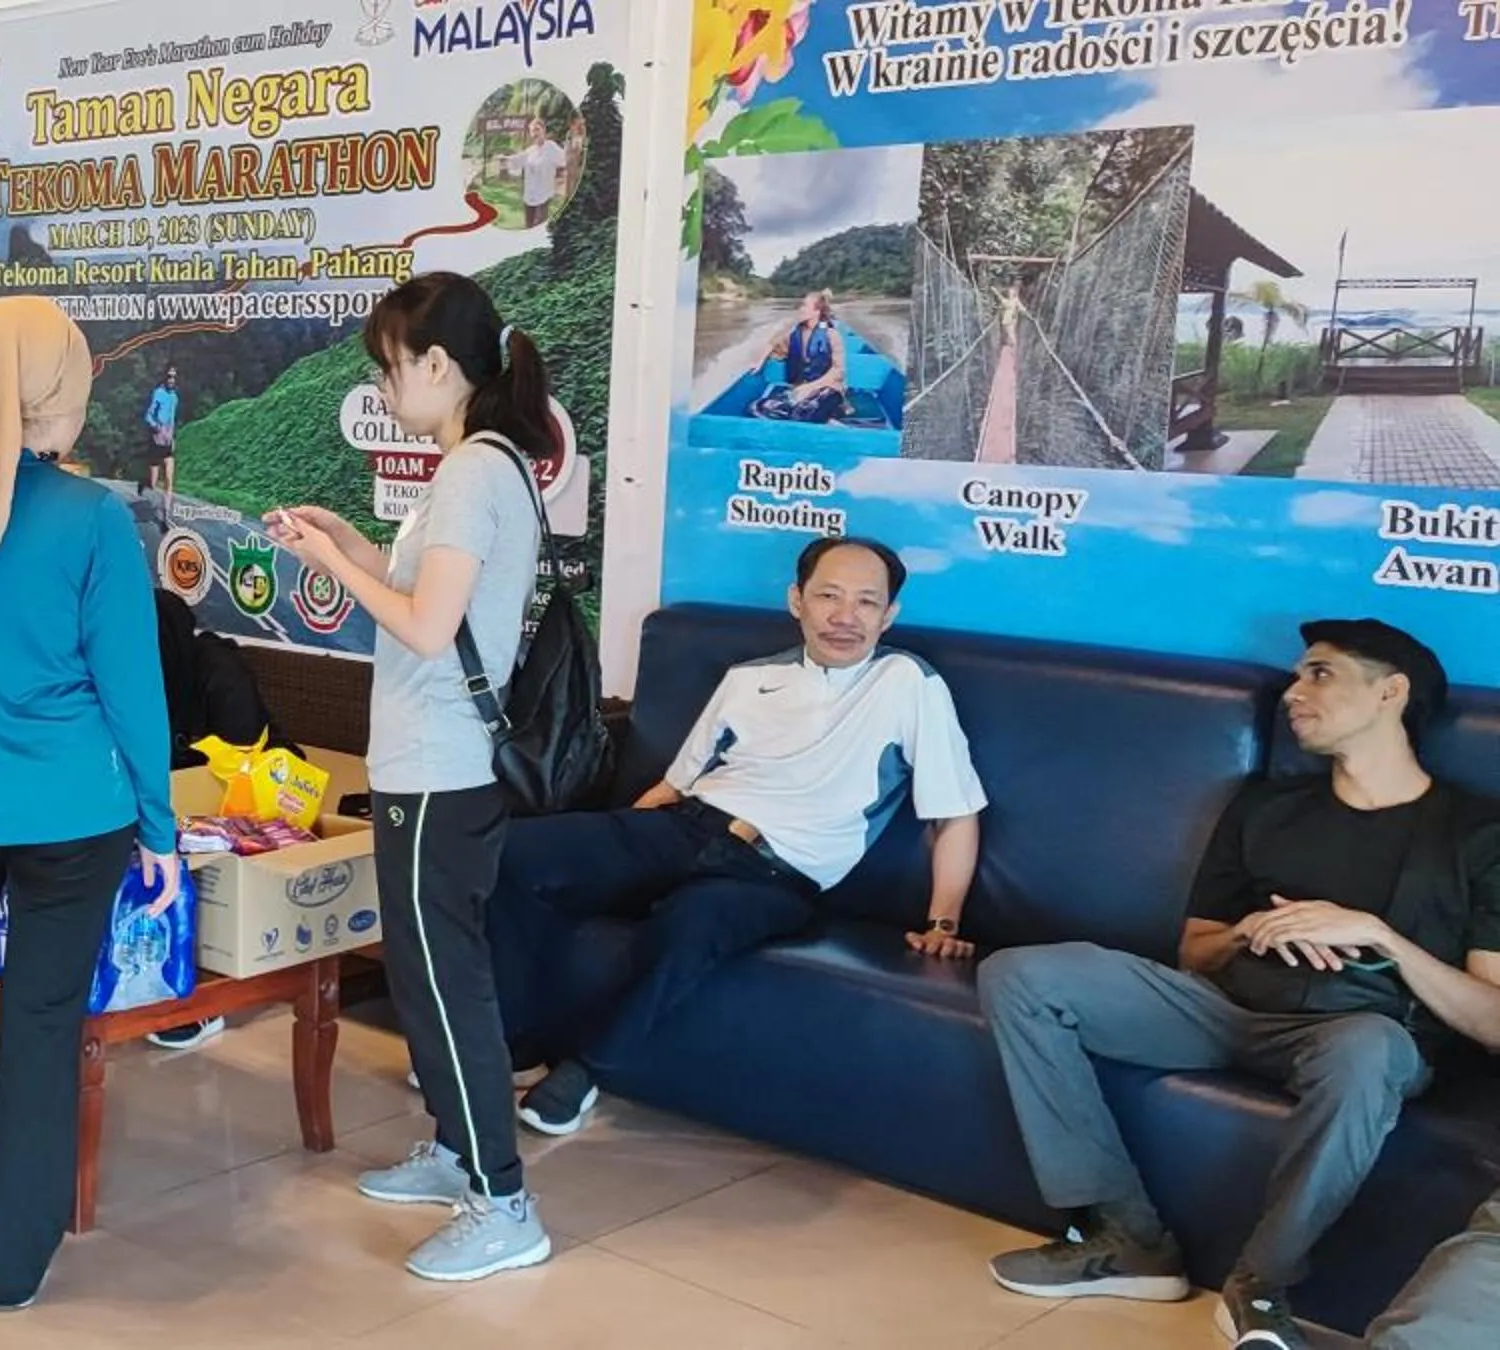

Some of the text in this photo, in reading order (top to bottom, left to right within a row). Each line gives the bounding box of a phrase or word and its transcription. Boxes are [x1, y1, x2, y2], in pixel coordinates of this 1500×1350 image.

[413, 0, 595, 67] MALAYSIA
[852, 3, 991, 42] Witamy
[1002, 0, 1036, 28] w
[58, 57, 88, 79] New
[91, 51, 122, 74] Year
[158, 34, 231, 65] Marathon
[232, 32, 267, 53] cum
[267, 20, 332, 50] Holiday
[827, 0, 1404, 93] W krainie radości i szczęścia!
[27, 62, 371, 144] Taman Negara
[152, 128, 438, 205] MARATHON
[47, 207, 316, 250] MARCH 19, 2023 (SUNDAY)
[73, 259, 144, 285] Resort
[148, 254, 214, 282] Kuala
[221, 252, 303, 285] Tahan,
[310, 246, 414, 286] Pahang
[376, 455, 424, 477] 10AM
[743, 462, 832, 496] Rapids
[730, 499, 842, 535] Shooting
[962, 479, 1082, 517] Canopy
[979, 520, 1063, 552] Walk
[1387, 504, 1500, 541] Bukit
[1380, 552, 1493, 588] Awan
